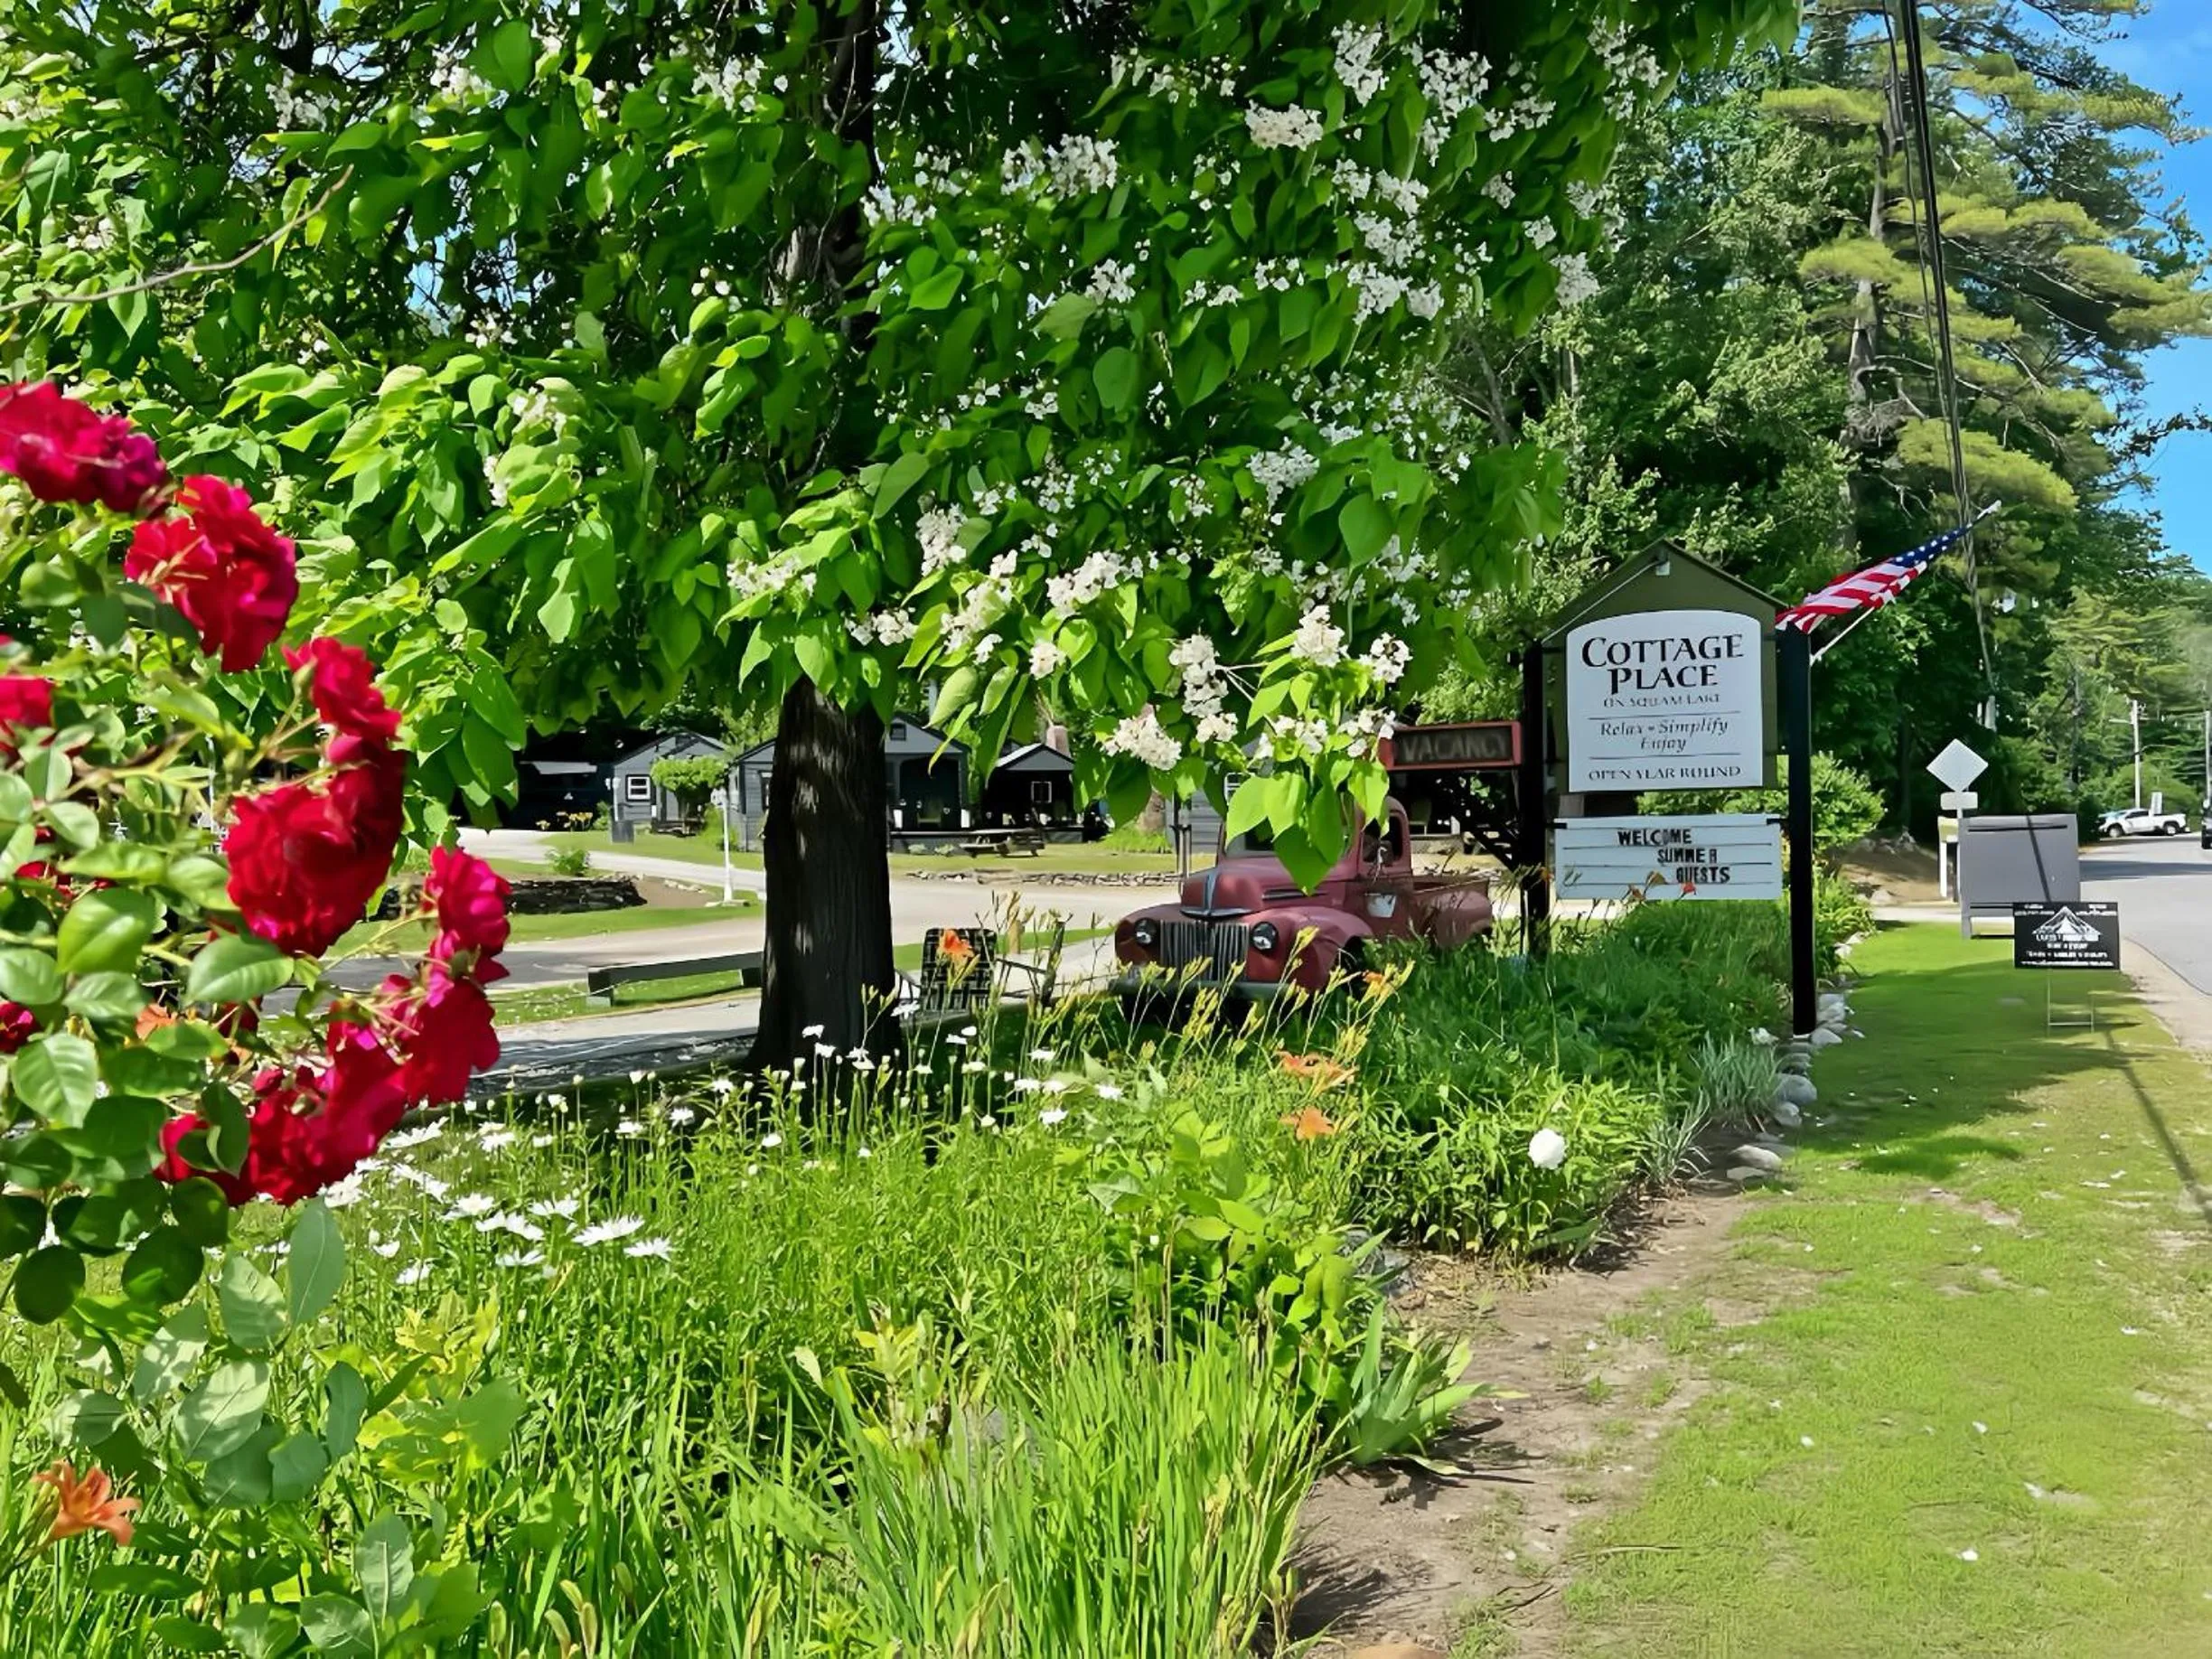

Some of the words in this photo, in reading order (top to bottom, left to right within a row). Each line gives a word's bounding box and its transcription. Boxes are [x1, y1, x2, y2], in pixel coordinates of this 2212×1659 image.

[1581, 633, 1744, 667] COTTAGE
[1607, 664, 1719, 695] PLACE
[1603, 698, 1625, 708] ON
[1600, 721, 1643, 736] Relax
[1658, 717, 1729, 737] Simplify
[1402, 731, 1507, 761] VACANCY
[1640, 736, 1687, 753] Enjoy
[1589, 768, 1631, 781] OPEN
[1680, 765, 1741, 778] ROUND
[1617, 829, 1692, 846] WELCOME
[1657, 848, 1717, 864] SUMMER
[1676, 866, 1730, 884] GUESTS
